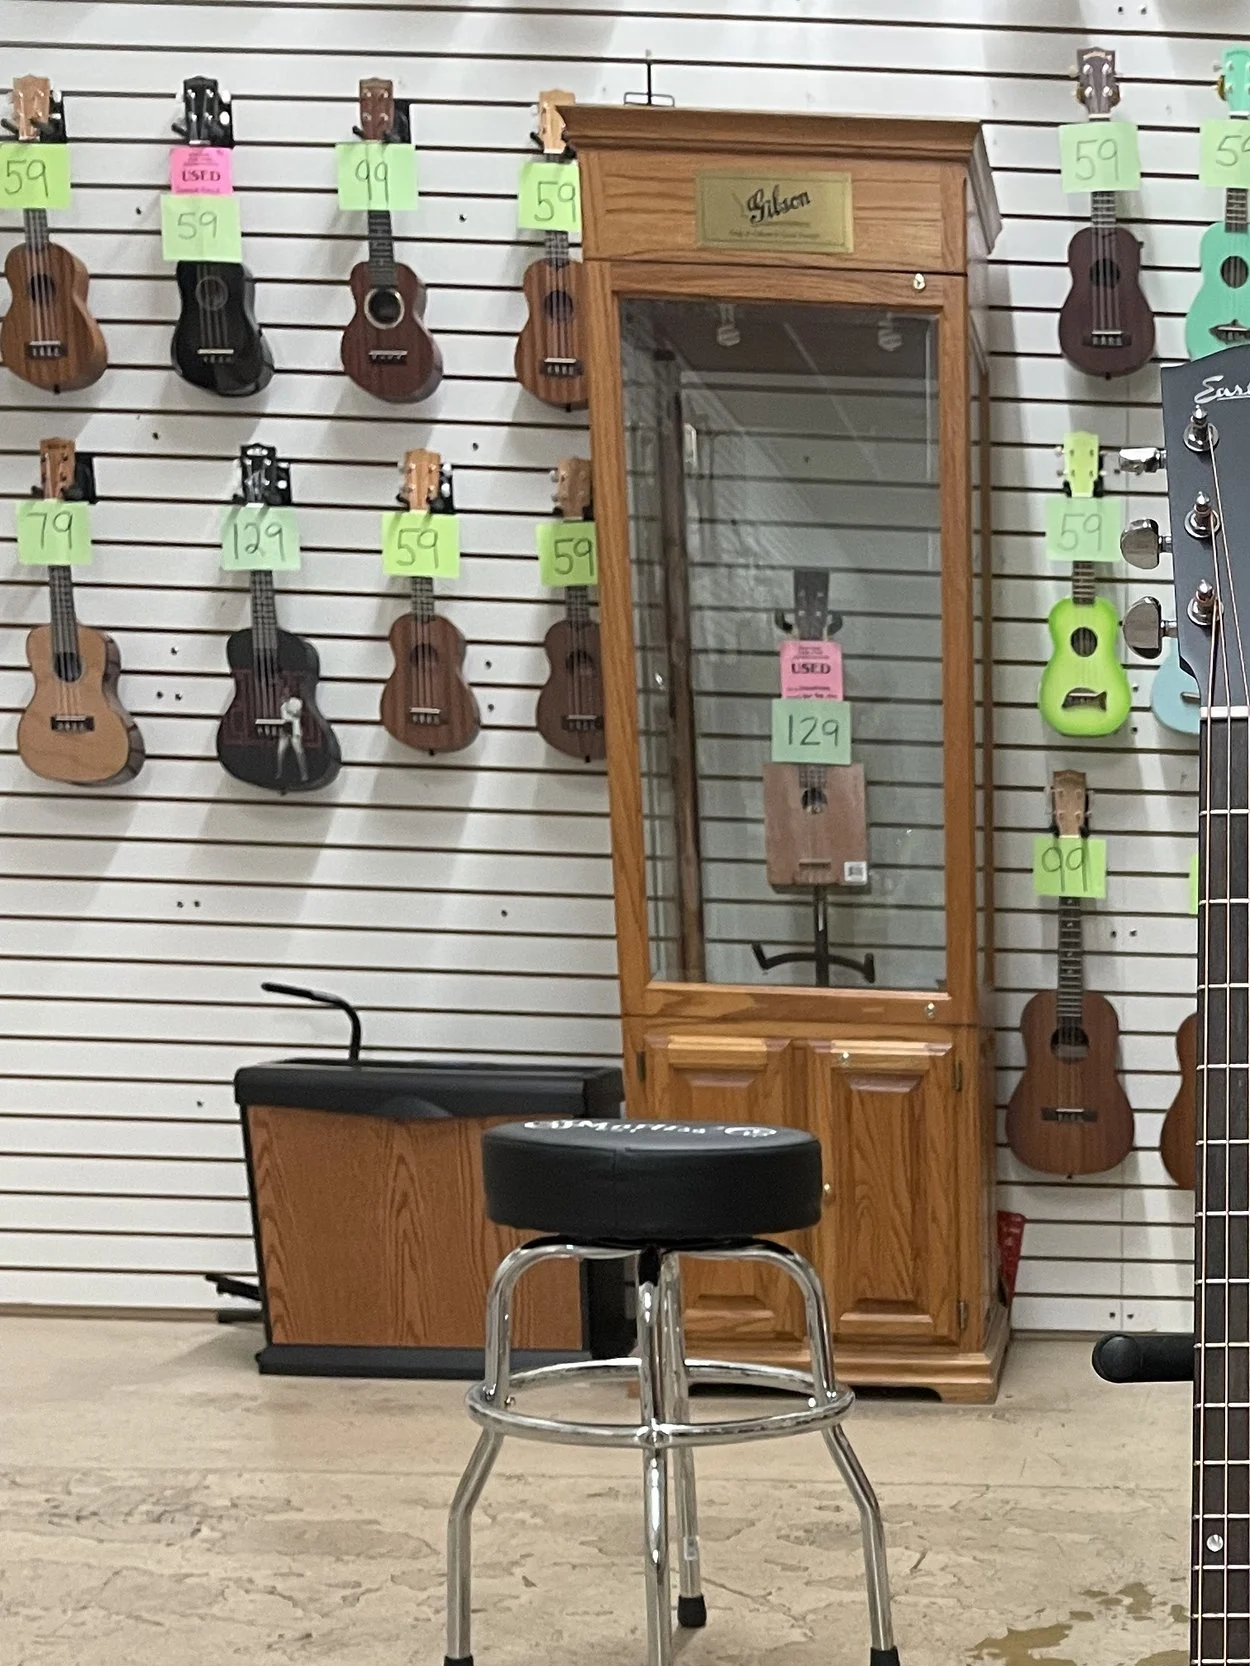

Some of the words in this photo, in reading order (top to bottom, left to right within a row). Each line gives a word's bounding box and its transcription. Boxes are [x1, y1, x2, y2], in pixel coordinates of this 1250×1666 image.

[5, 159, 49, 198] 59
[1075, 138, 1120, 182] 59
[355, 159, 389, 208] 99
[534, 181, 577, 223] 59
[747, 184, 811, 224] Gibson
[177, 211, 219, 240] 59
[26, 511, 73, 550] 79
[232, 522, 286, 562] 129
[396, 528, 439, 569] 59
[1056, 513, 1103, 552] 59
[554, 537, 595, 577] 59
[791, 662, 831, 675] USED
[788, 714, 840, 747] 129
[1042, 847, 1087, 893] 99
